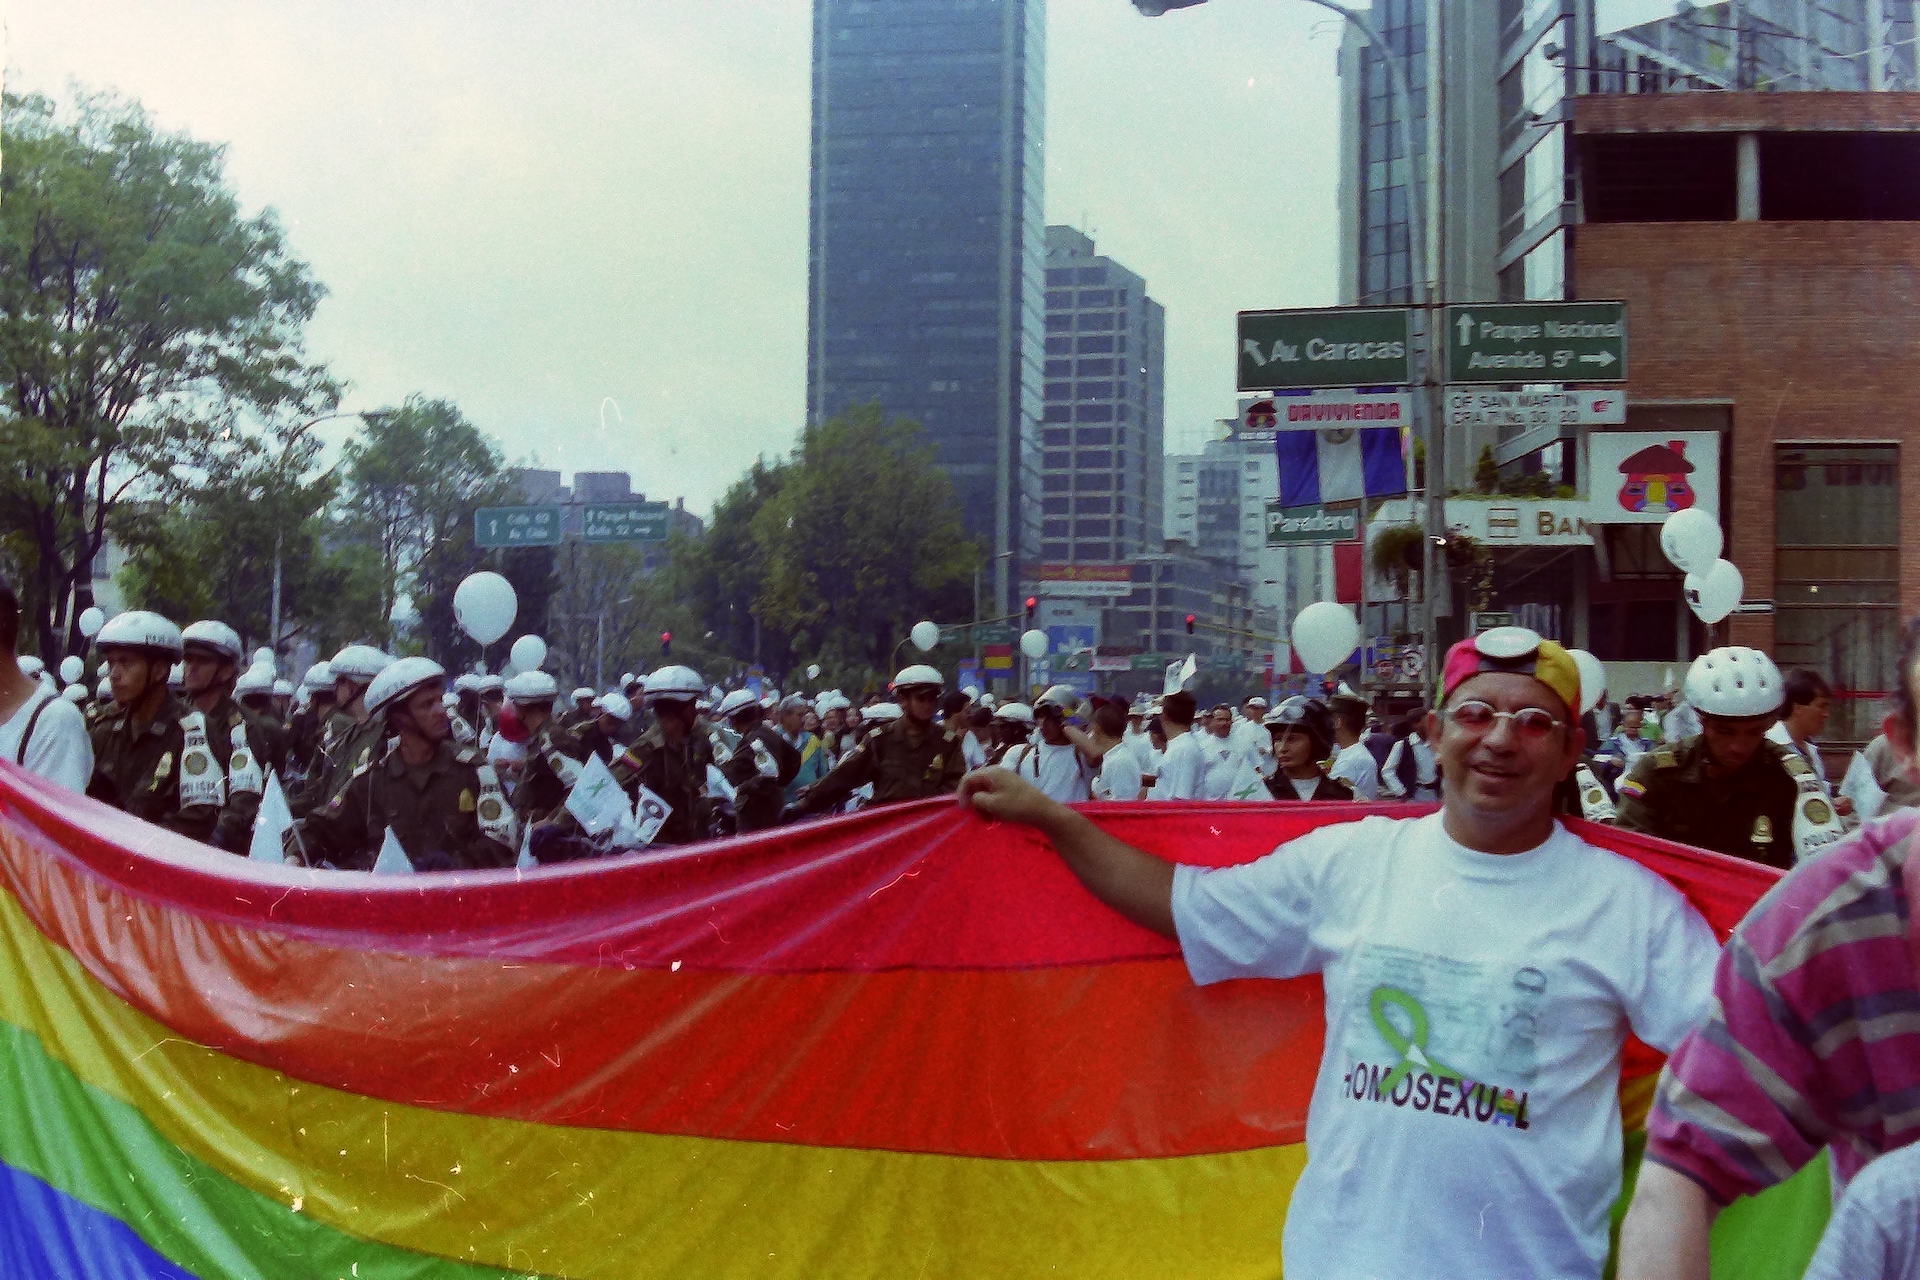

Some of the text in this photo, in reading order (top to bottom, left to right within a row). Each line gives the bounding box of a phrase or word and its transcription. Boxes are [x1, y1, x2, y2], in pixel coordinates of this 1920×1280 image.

[1480, 320, 1624, 343] Parque Nacional
[1306, 337, 1406, 361] Caracas
[1468, 351, 1546, 369] Avenida
[1480, 395, 1511, 409] SAN
[1518, 394, 1580, 408] MARTIN
[1288, 403, 1400, 421] DAVIVIENDA
[1267, 509, 1354, 534] Paradero
